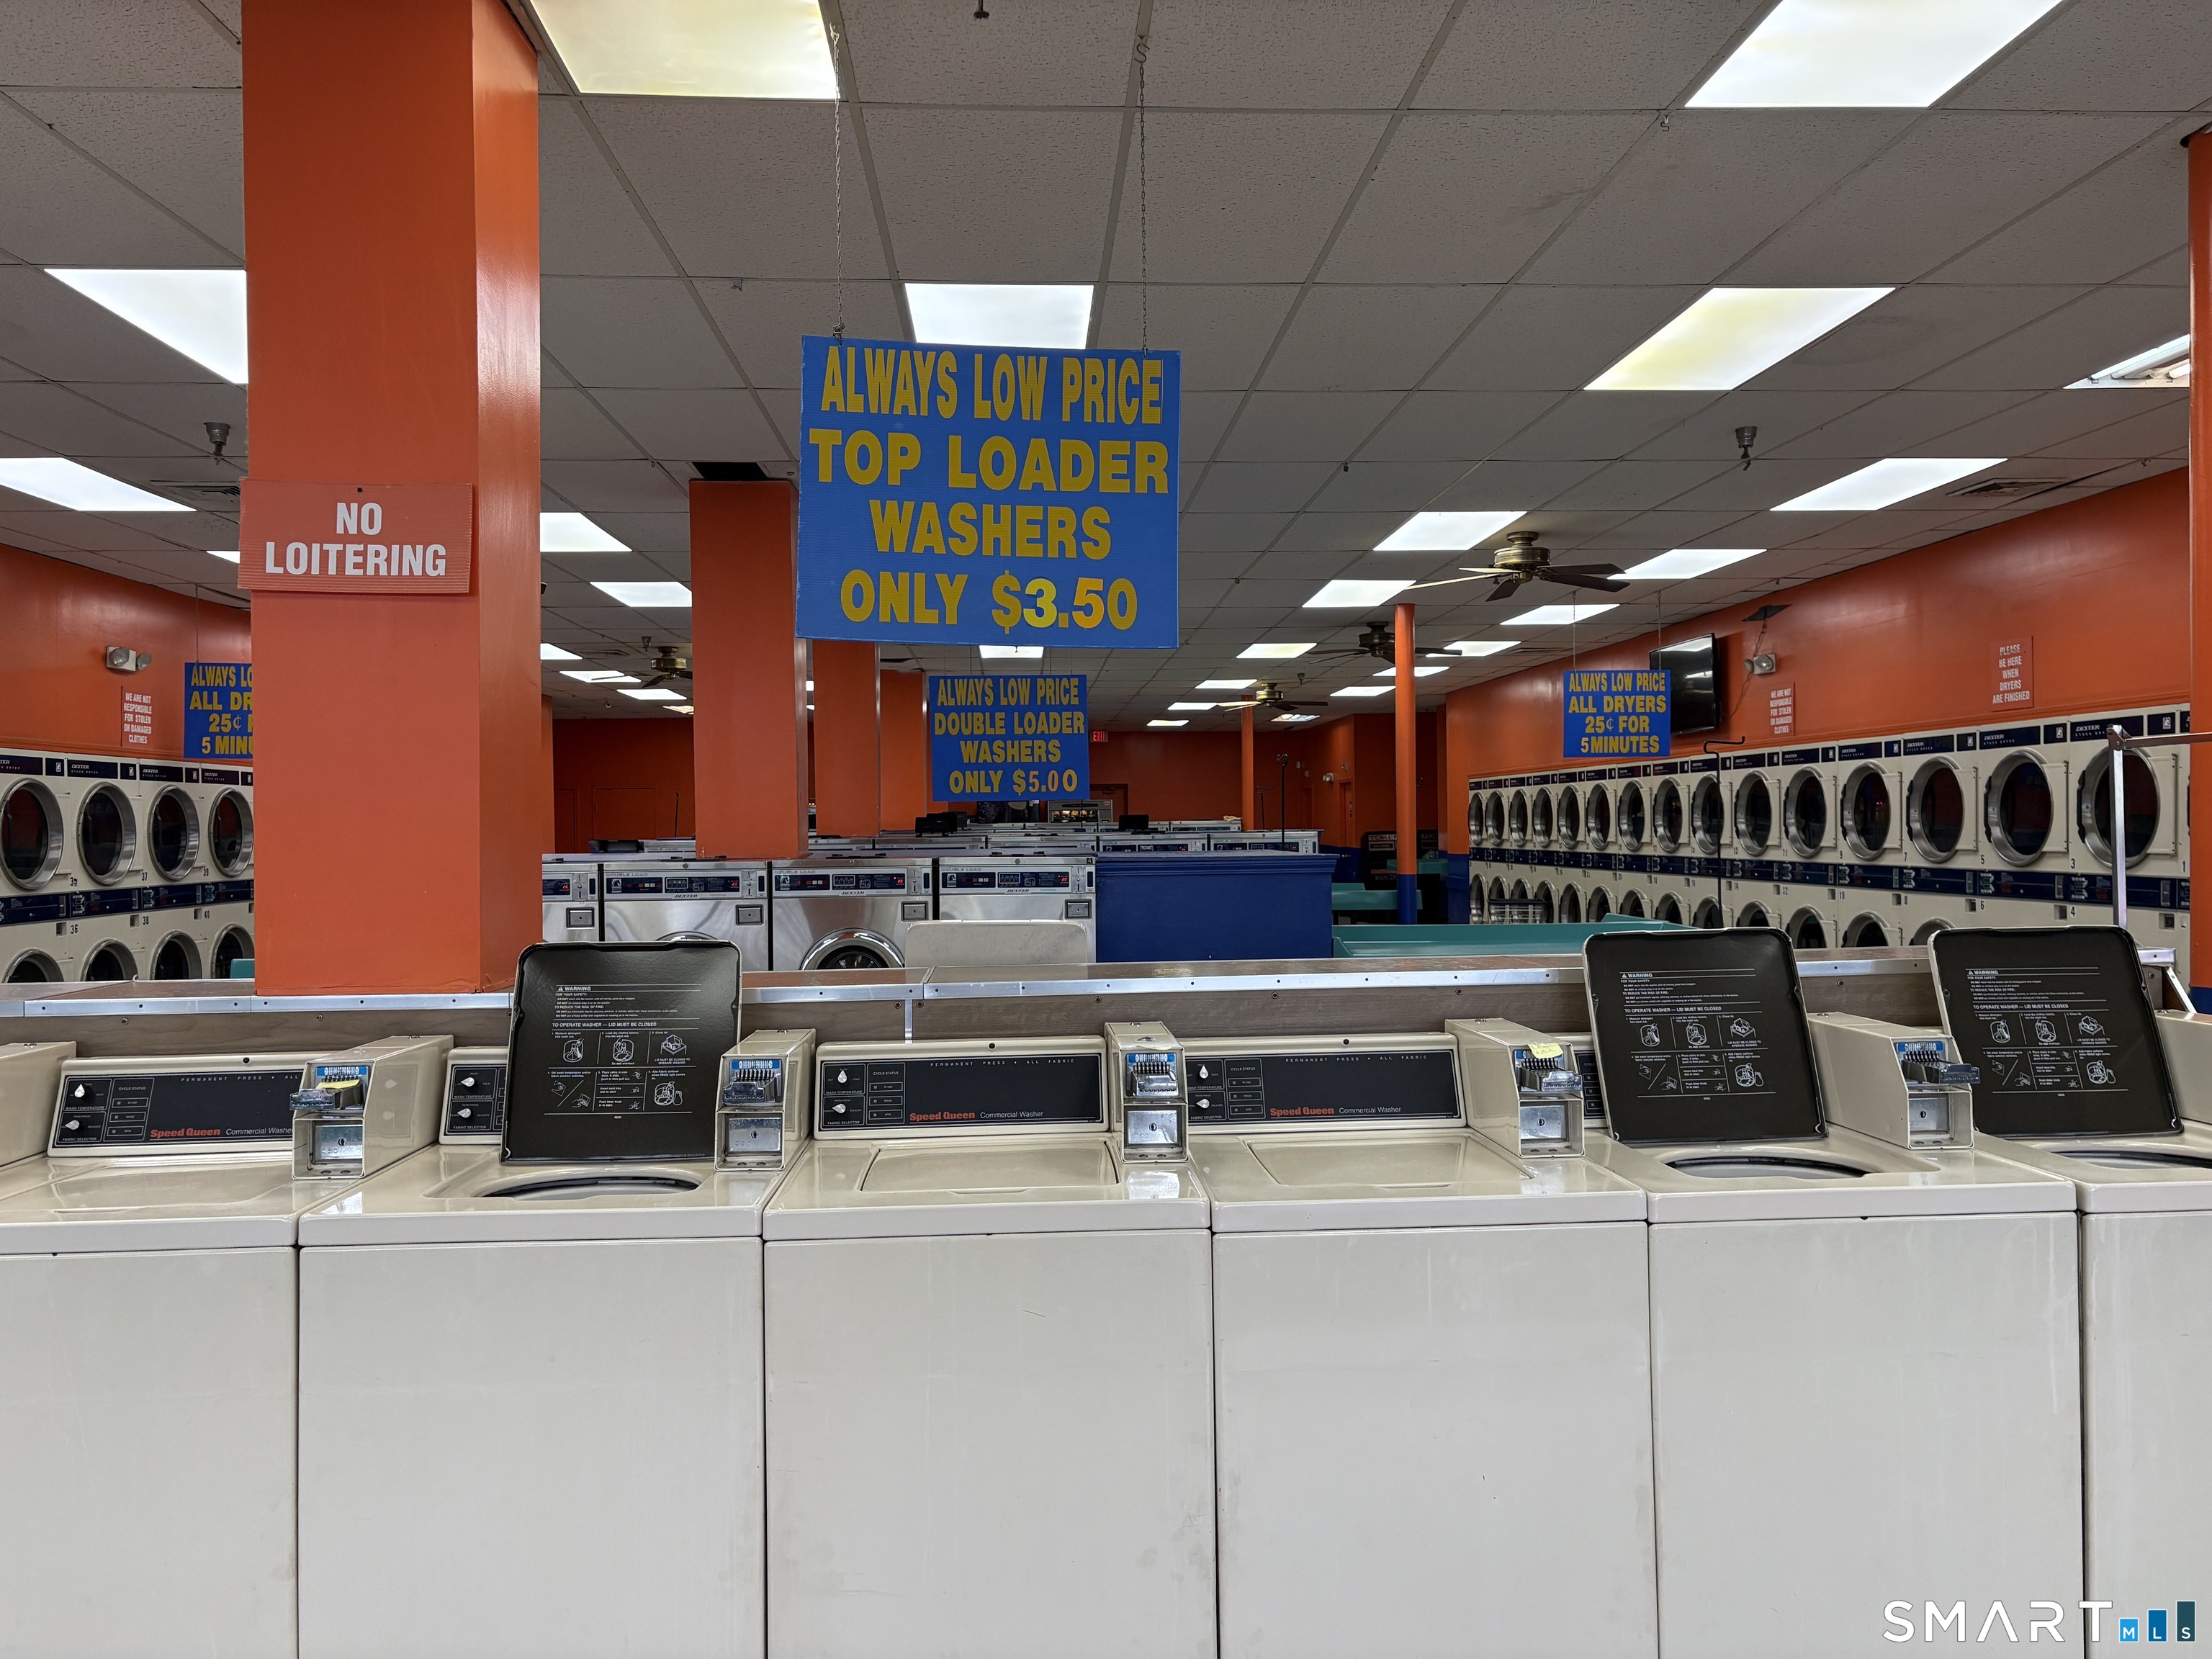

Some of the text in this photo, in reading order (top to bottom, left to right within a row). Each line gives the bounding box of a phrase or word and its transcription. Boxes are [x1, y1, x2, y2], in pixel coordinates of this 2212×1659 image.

[821, 346, 1162, 425] ALWAYS LOW PRICE
[809, 428, 1169, 494] TOP LOADER
[336, 502, 382, 536] NO
[869, 499, 1112, 560] WASHERS
[265, 541, 446, 577] LOITERING
[840, 569, 1138, 634] ONLY $3.50
[2000, 644, 2020, 656] PLEASE
[1999, 655, 2022, 668] BE HERE
[191, 665, 253, 688] ALWAYS LO
[2002, 668, 2019, 679] WHEN
[1569, 672, 1665, 693] ALWAYS LOW PRICE
[2000, 679, 2022, 691] DRYERS
[937, 677, 1079, 706] ALWAYS LOW PRICE
[1992, 691, 2030, 704] ARE FINISHED
[125, 693, 151, 703] WE ARE NOT
[189, 691, 222, 711] ALL
[124, 703, 152, 714] RESPONSIBLE
[1568, 695, 1667, 714] ALL DRYERS
[124, 714, 151, 724] FOR STOLEN
[209, 713, 242, 733] 25¢
[934, 711, 1085, 736] DOUBLE LOADER
[1585, 715, 1650, 734] 25¢ FOR
[124, 724, 152, 734] OR DAMAGED
[128, 734, 148, 744] CLOTHES
[1092, 730, 1106, 742] EXIT
[202, 736, 211, 754] 5
[1581, 734, 1660, 754] 5 MINUTES
[960, 739, 1061, 763] WASHERS
[949, 768, 1078, 796] ONLY $5.00
[1904, 853, 1908, 862] 7
[1980, 855, 1985, 864] 5
[2070, 858, 2075, 869] 3
[2182, 861, 2186, 872] 1
[141, 873, 148, 881] 37
[1839, 891, 1845, 900] 10
[1904, 896, 1908, 905] 8
[1980, 901, 1984, 910] 6
[204, 910, 210, 920] 40
[2070, 907, 2076, 917] 4
[142, 916, 150, 925] 38
[71, 925, 78, 935] 36
[909, 1112, 942, 1122] Speed
[1270, 1107, 1301, 1117] Speed
[1302, 1106, 1335, 1115] Queen
[150, 1126, 294, 1138] Speed Queen Commercial Washe
